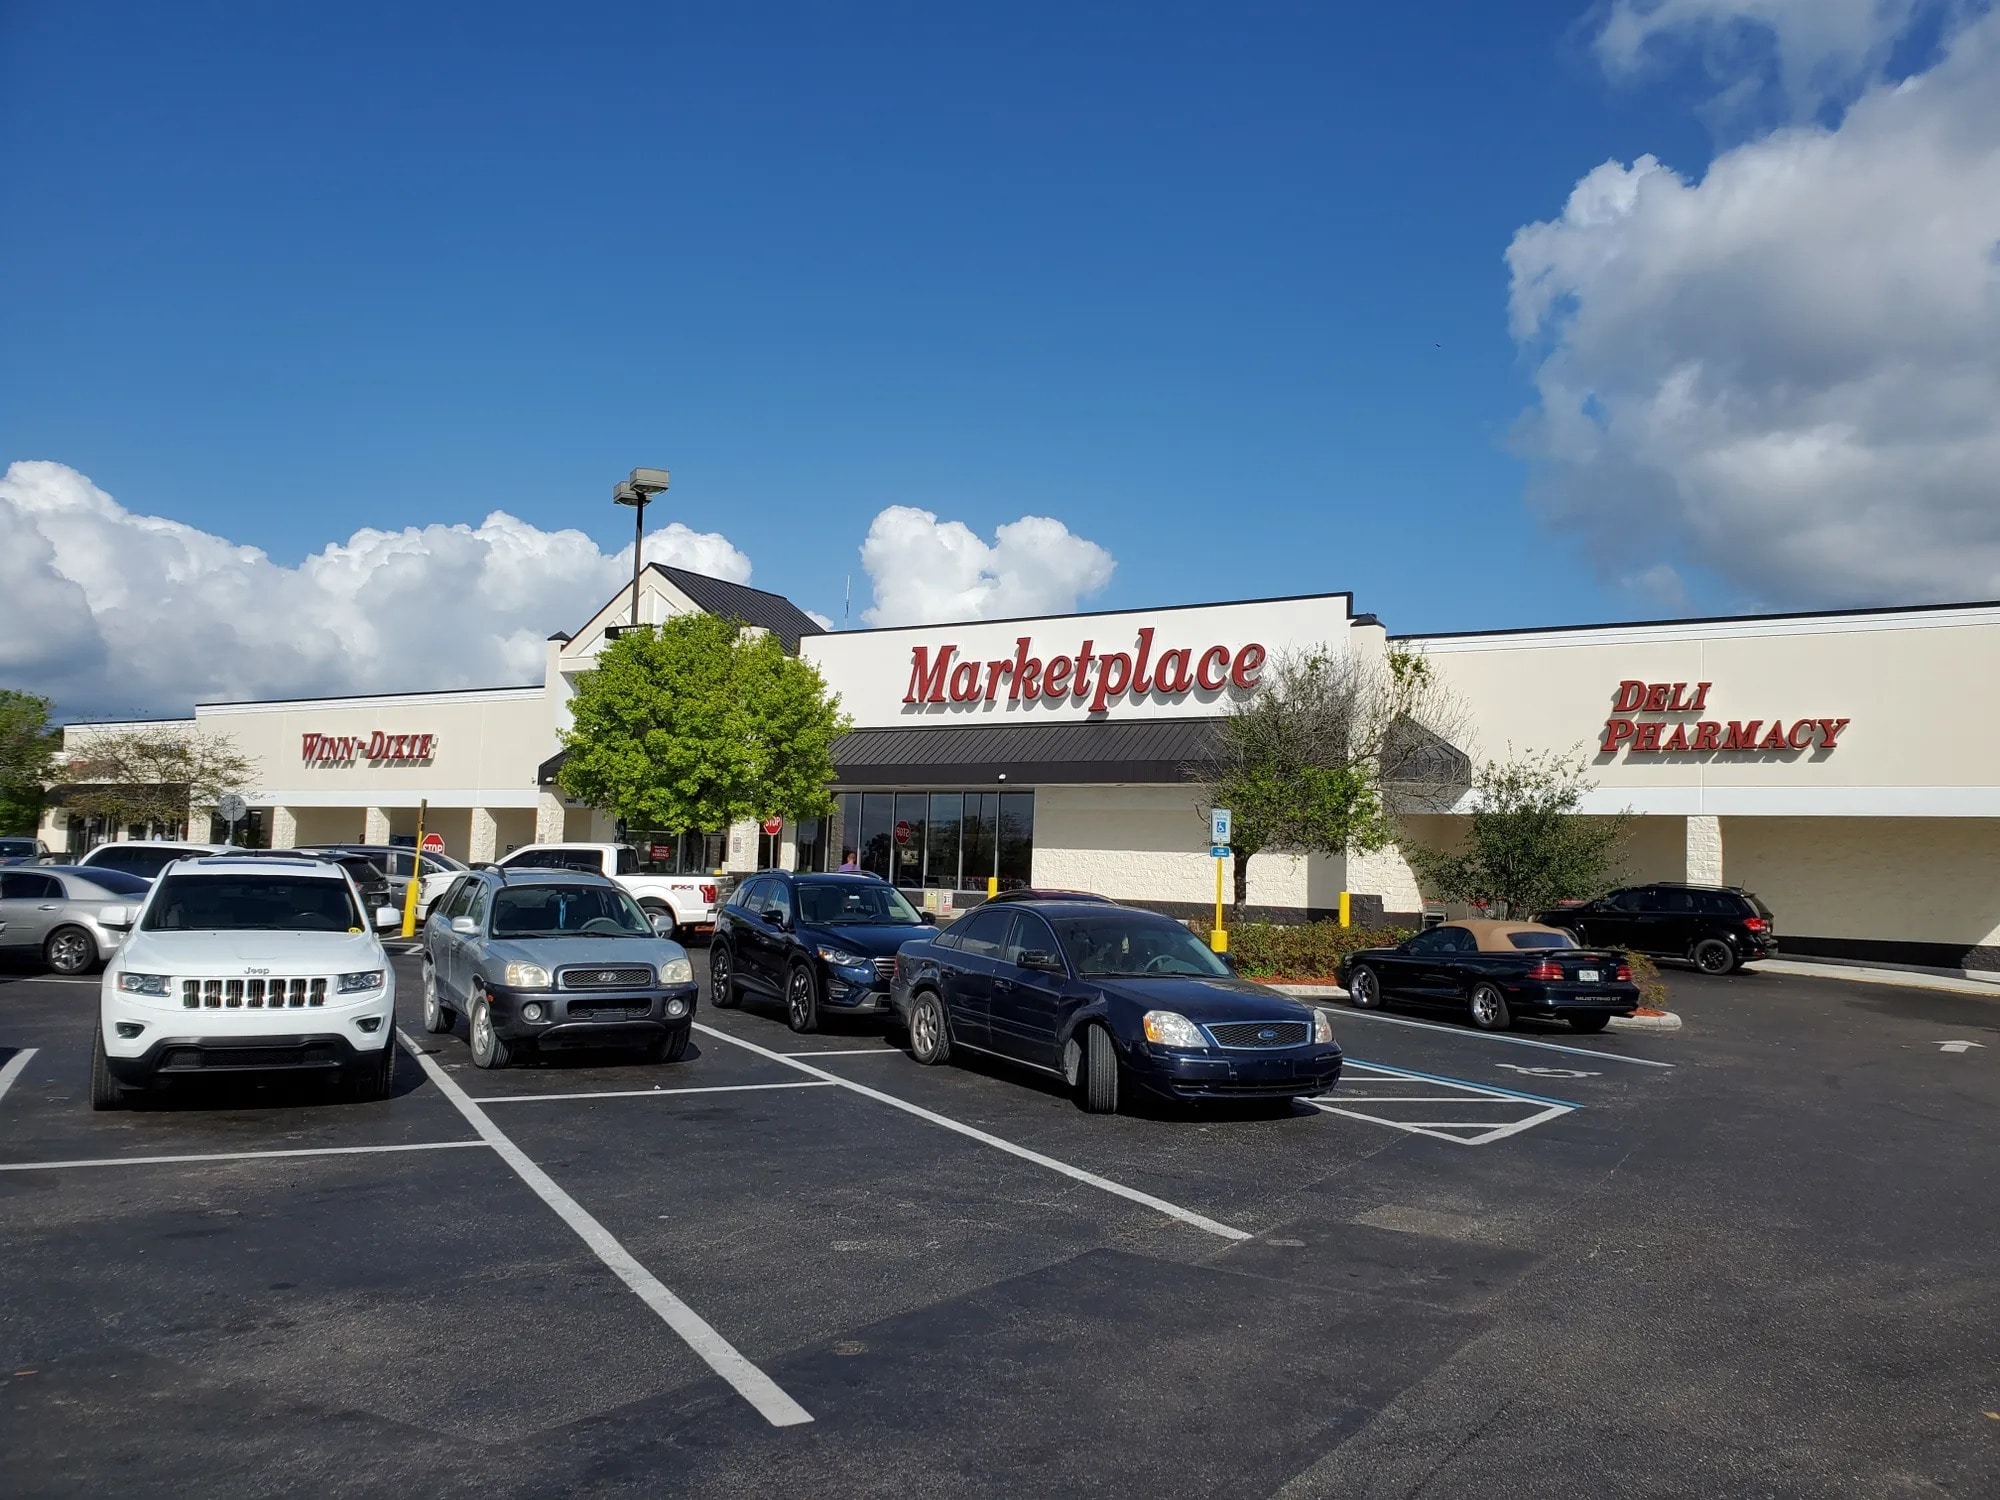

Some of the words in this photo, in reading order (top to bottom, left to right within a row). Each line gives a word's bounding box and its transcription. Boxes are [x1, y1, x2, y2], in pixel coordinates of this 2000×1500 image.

[902, 627, 1266, 712] Marketplace
[1613, 680, 1713, 712] DELI
[302, 730, 434, 760] WINN-DIXIE
[1601, 718, 1851, 751] PHARMACY
[765, 816, 780, 827] STOP
[423, 843, 443, 853] STOP
[243, 966, 270, 975] Jeep
